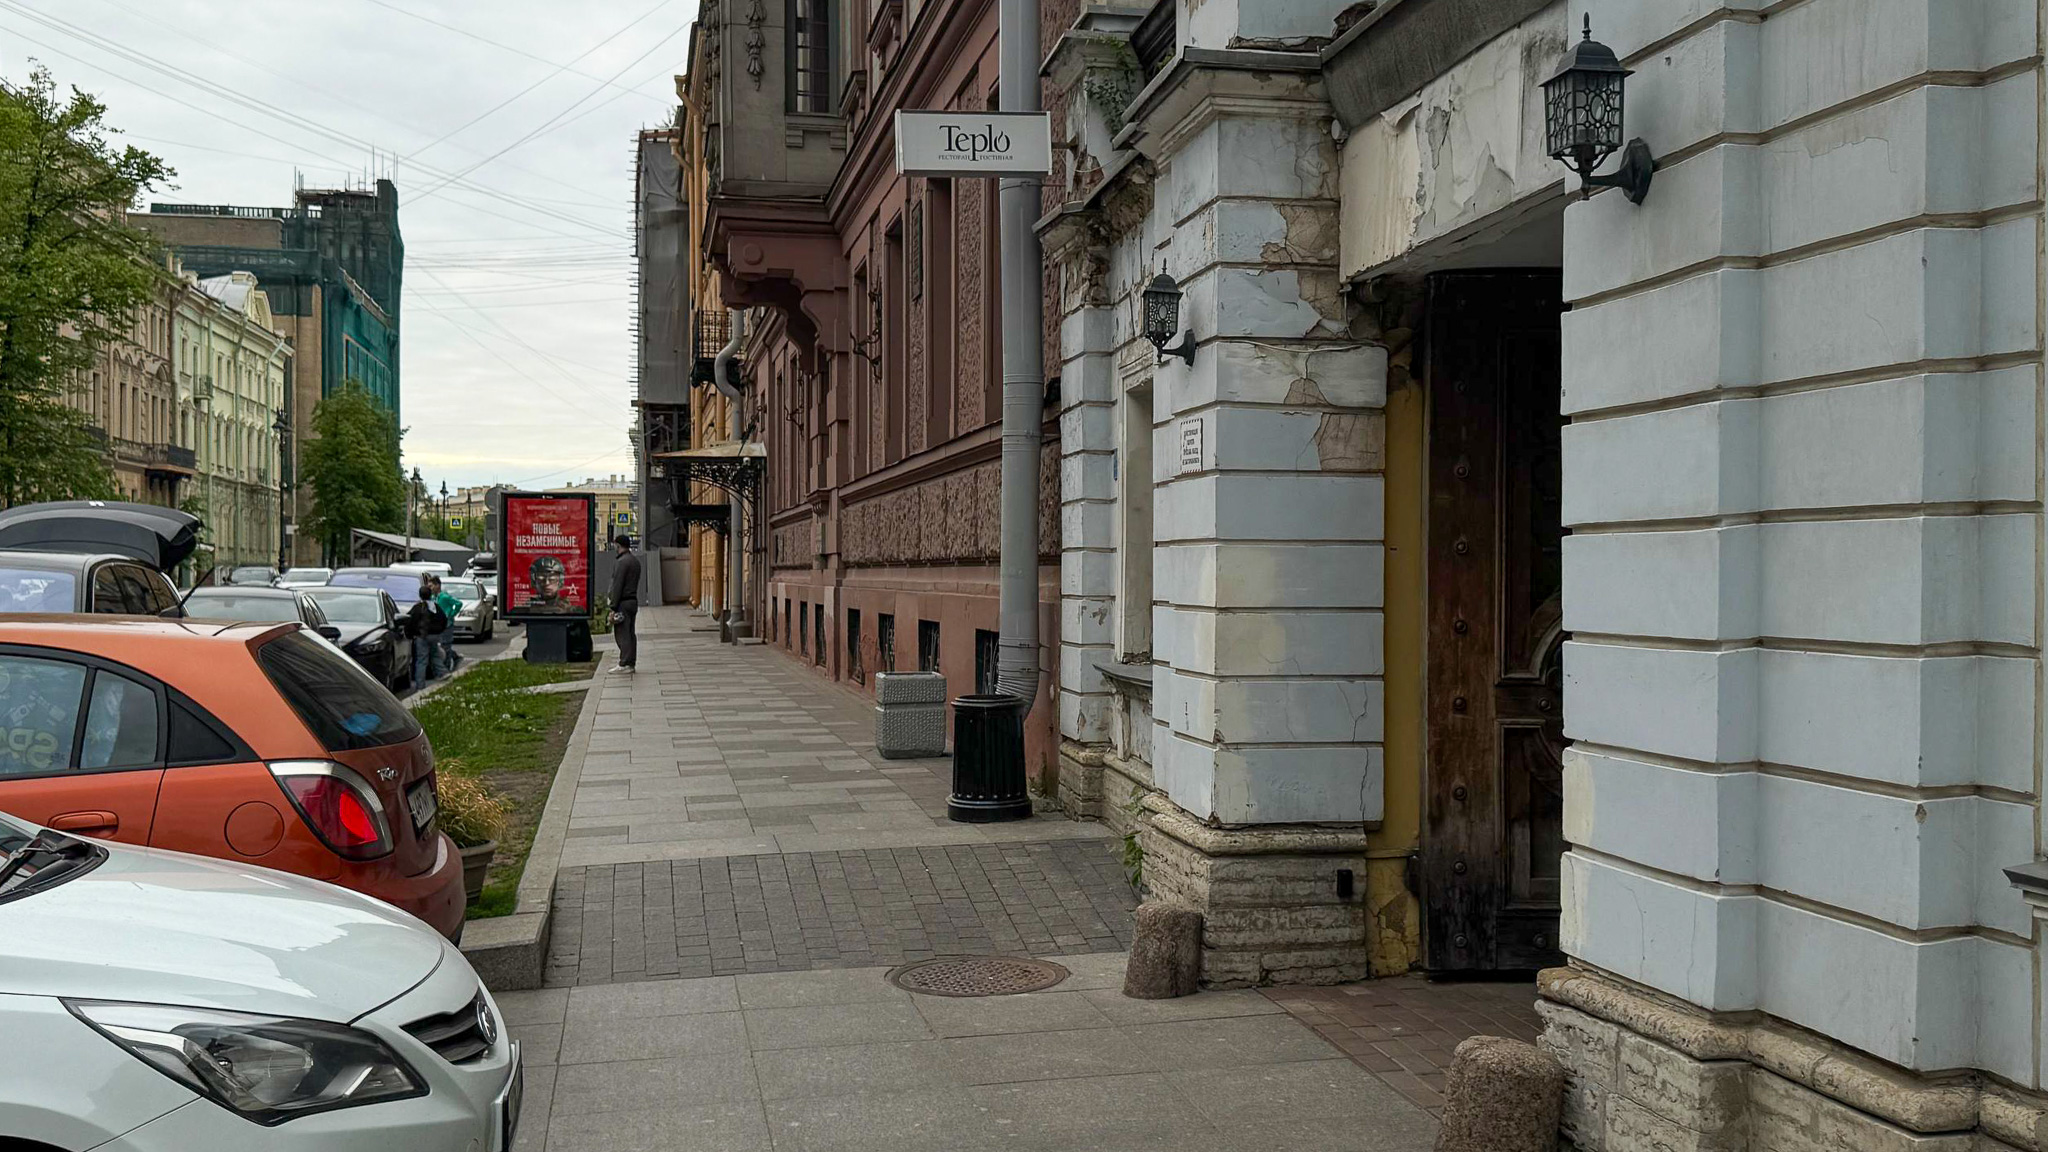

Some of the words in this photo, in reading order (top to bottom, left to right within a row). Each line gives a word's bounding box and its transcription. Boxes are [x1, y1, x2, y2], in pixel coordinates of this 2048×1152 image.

[939, 124, 1010, 161] Teplo
[532, 523, 562, 534] НОВЫЕ.
[516, 535, 578, 547] НЕЗАМЕНИМЫЕ.
